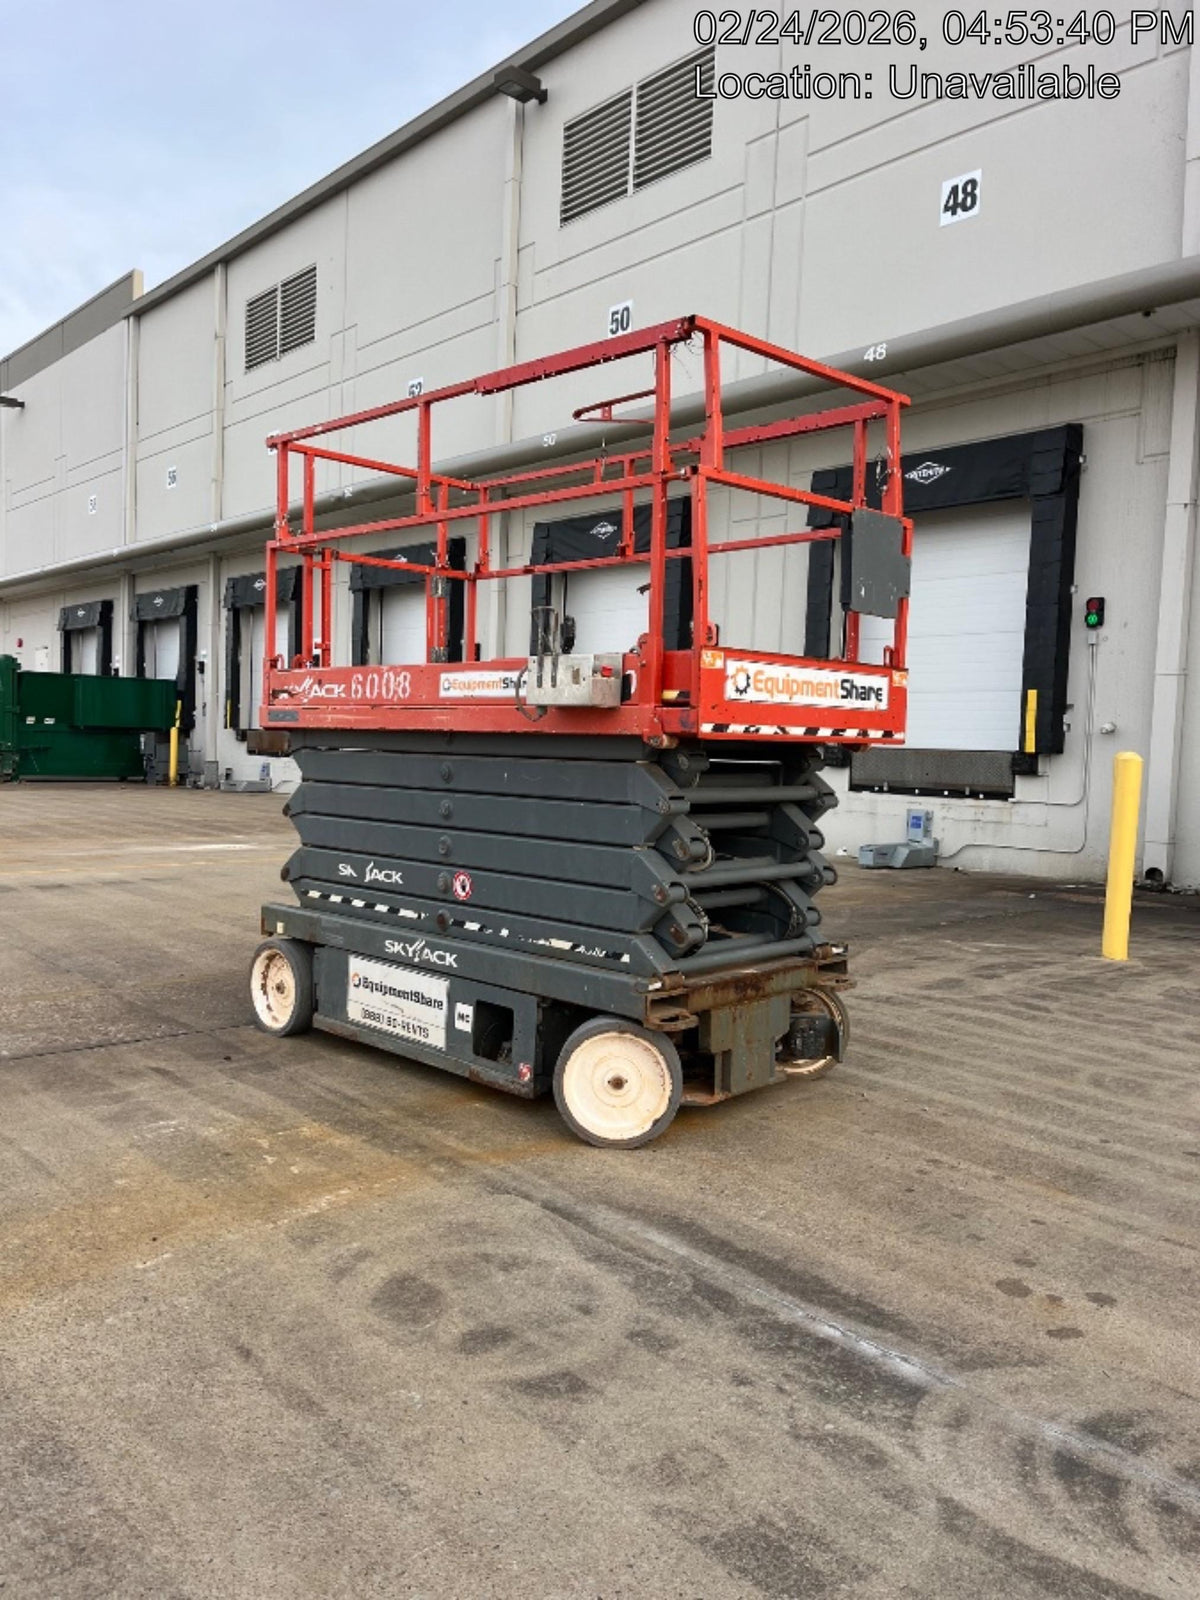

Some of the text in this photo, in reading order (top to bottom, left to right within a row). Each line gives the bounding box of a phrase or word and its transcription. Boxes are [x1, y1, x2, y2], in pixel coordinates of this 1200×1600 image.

[943, 178, 978, 216] 48
[610, 305, 630, 335] 50
[863, 342, 887, 362] 48
[543, 433, 557, 447] 50
[351, 671, 411, 699] 6008
[753, 669, 883, 702] EquipmentShare
[385, 939, 458, 969] SKYJACK
[362, 976, 444, 1011] EquipmentShare
